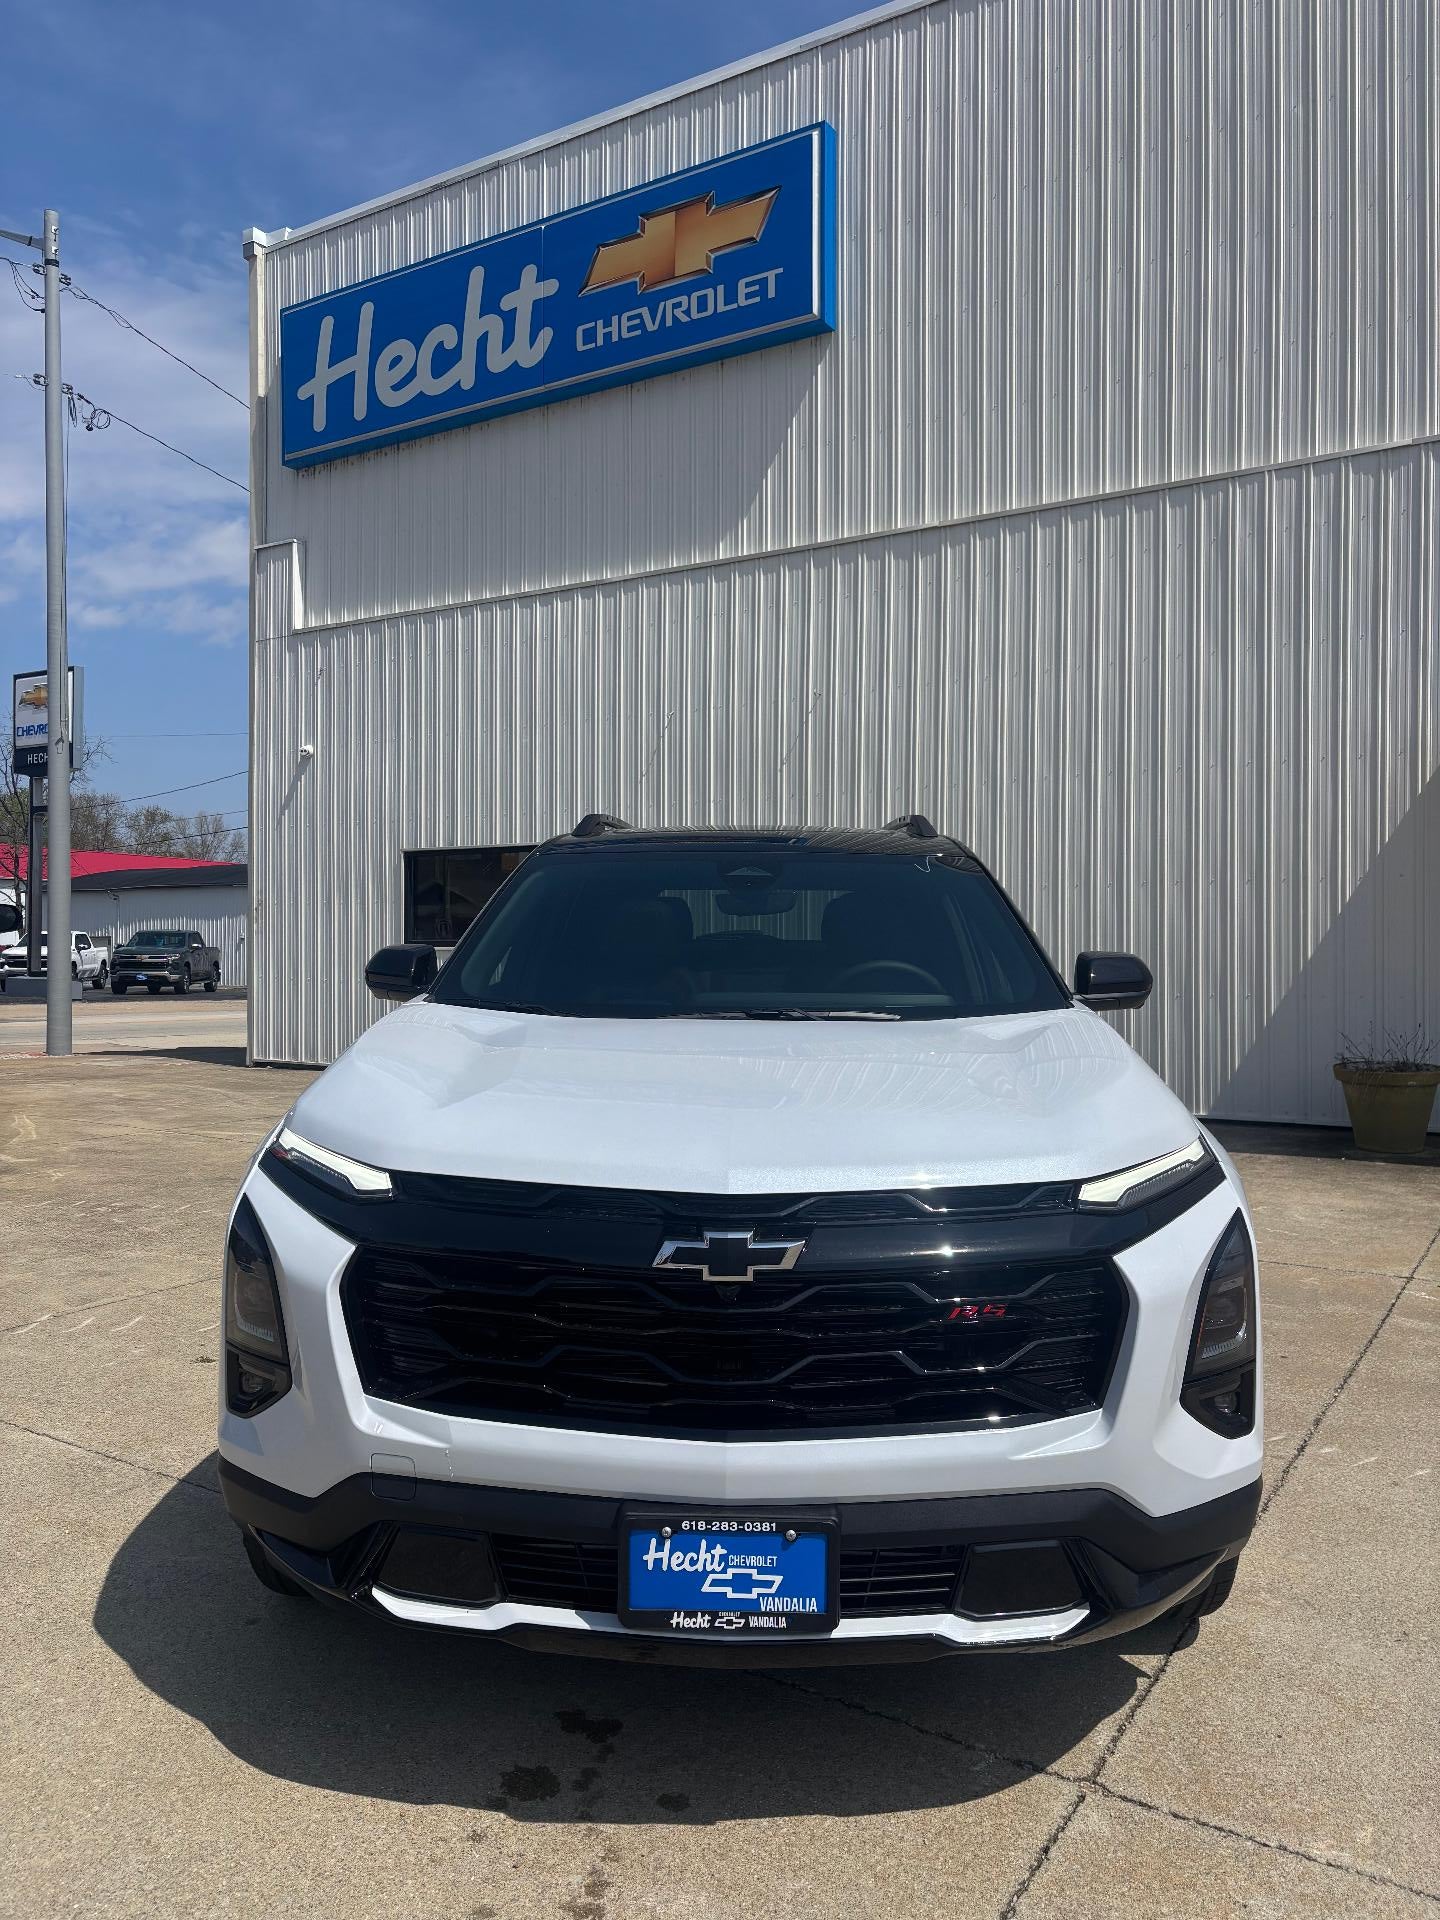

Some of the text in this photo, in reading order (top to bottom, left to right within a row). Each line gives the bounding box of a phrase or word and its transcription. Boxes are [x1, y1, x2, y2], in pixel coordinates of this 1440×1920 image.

[576, 268, 784, 351] CHEVROLET
[297, 265, 559, 432] Hecht
[949, 1304, 1008, 1320] RS
[682, 1520, 777, 1532] 618-283-0381
[643, 1538, 778, 1572] Hecht CHEVROLET
[759, 1597, 818, 1612] VANDALIA
[670, 1611, 711, 1628] Hecht
[748, 1616, 787, 1628] VANDALIA
